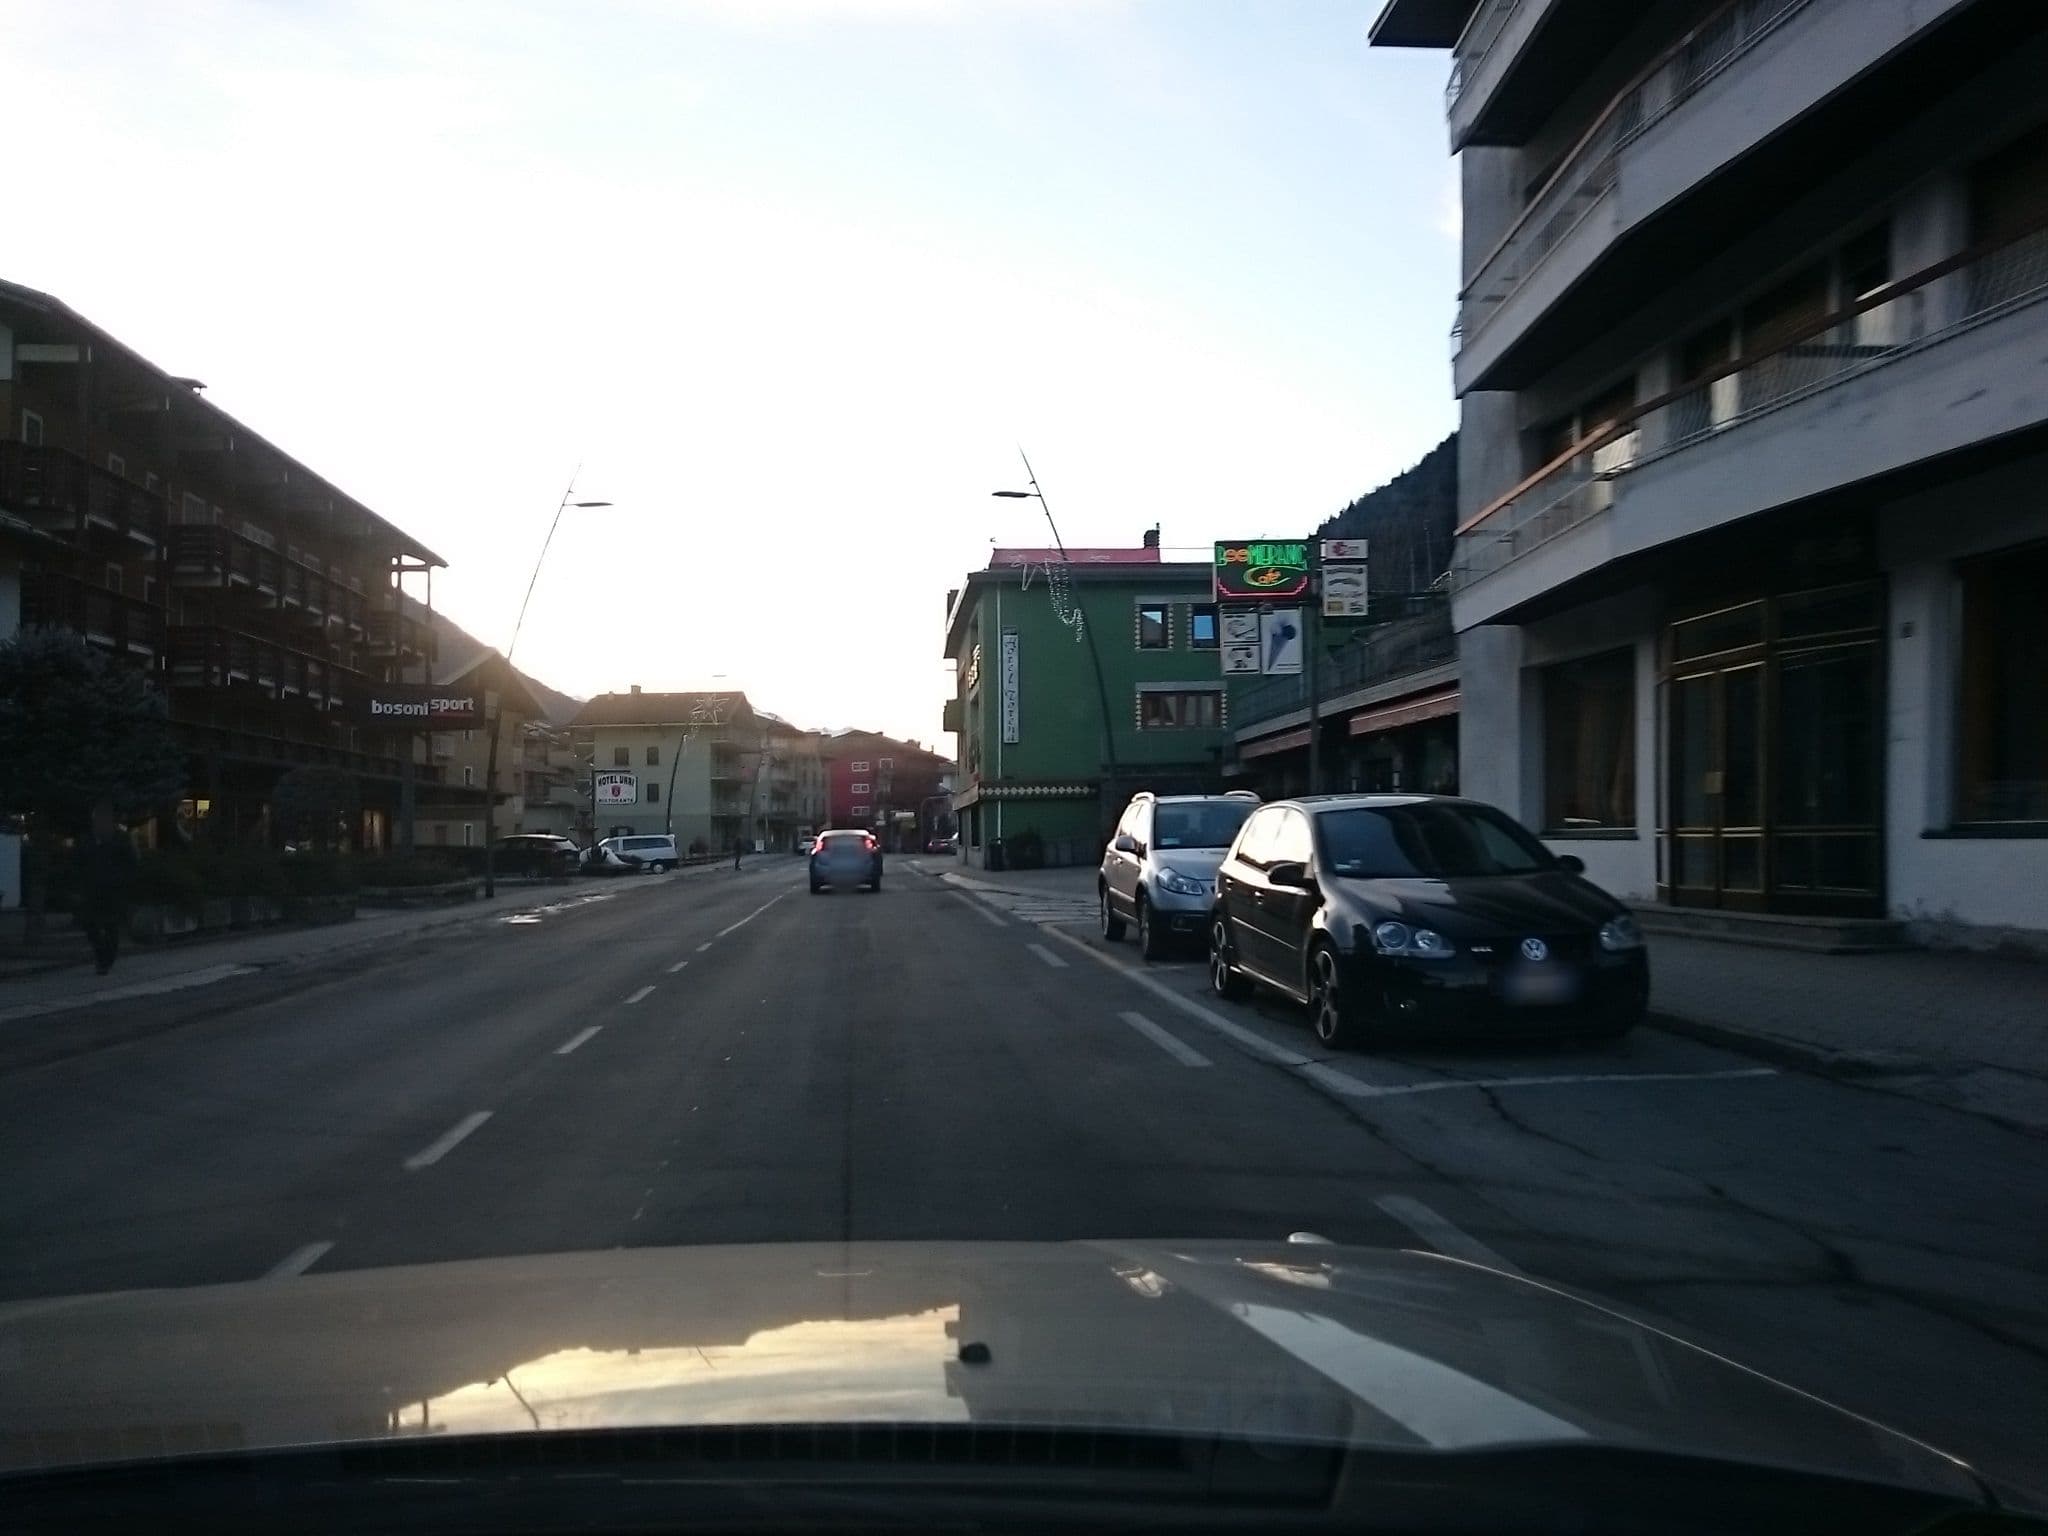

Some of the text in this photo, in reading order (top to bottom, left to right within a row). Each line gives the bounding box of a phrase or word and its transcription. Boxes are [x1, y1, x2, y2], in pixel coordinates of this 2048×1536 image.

[371, 697, 474, 716] bosoni sport
[597, 775, 618, 787] HOTEL
